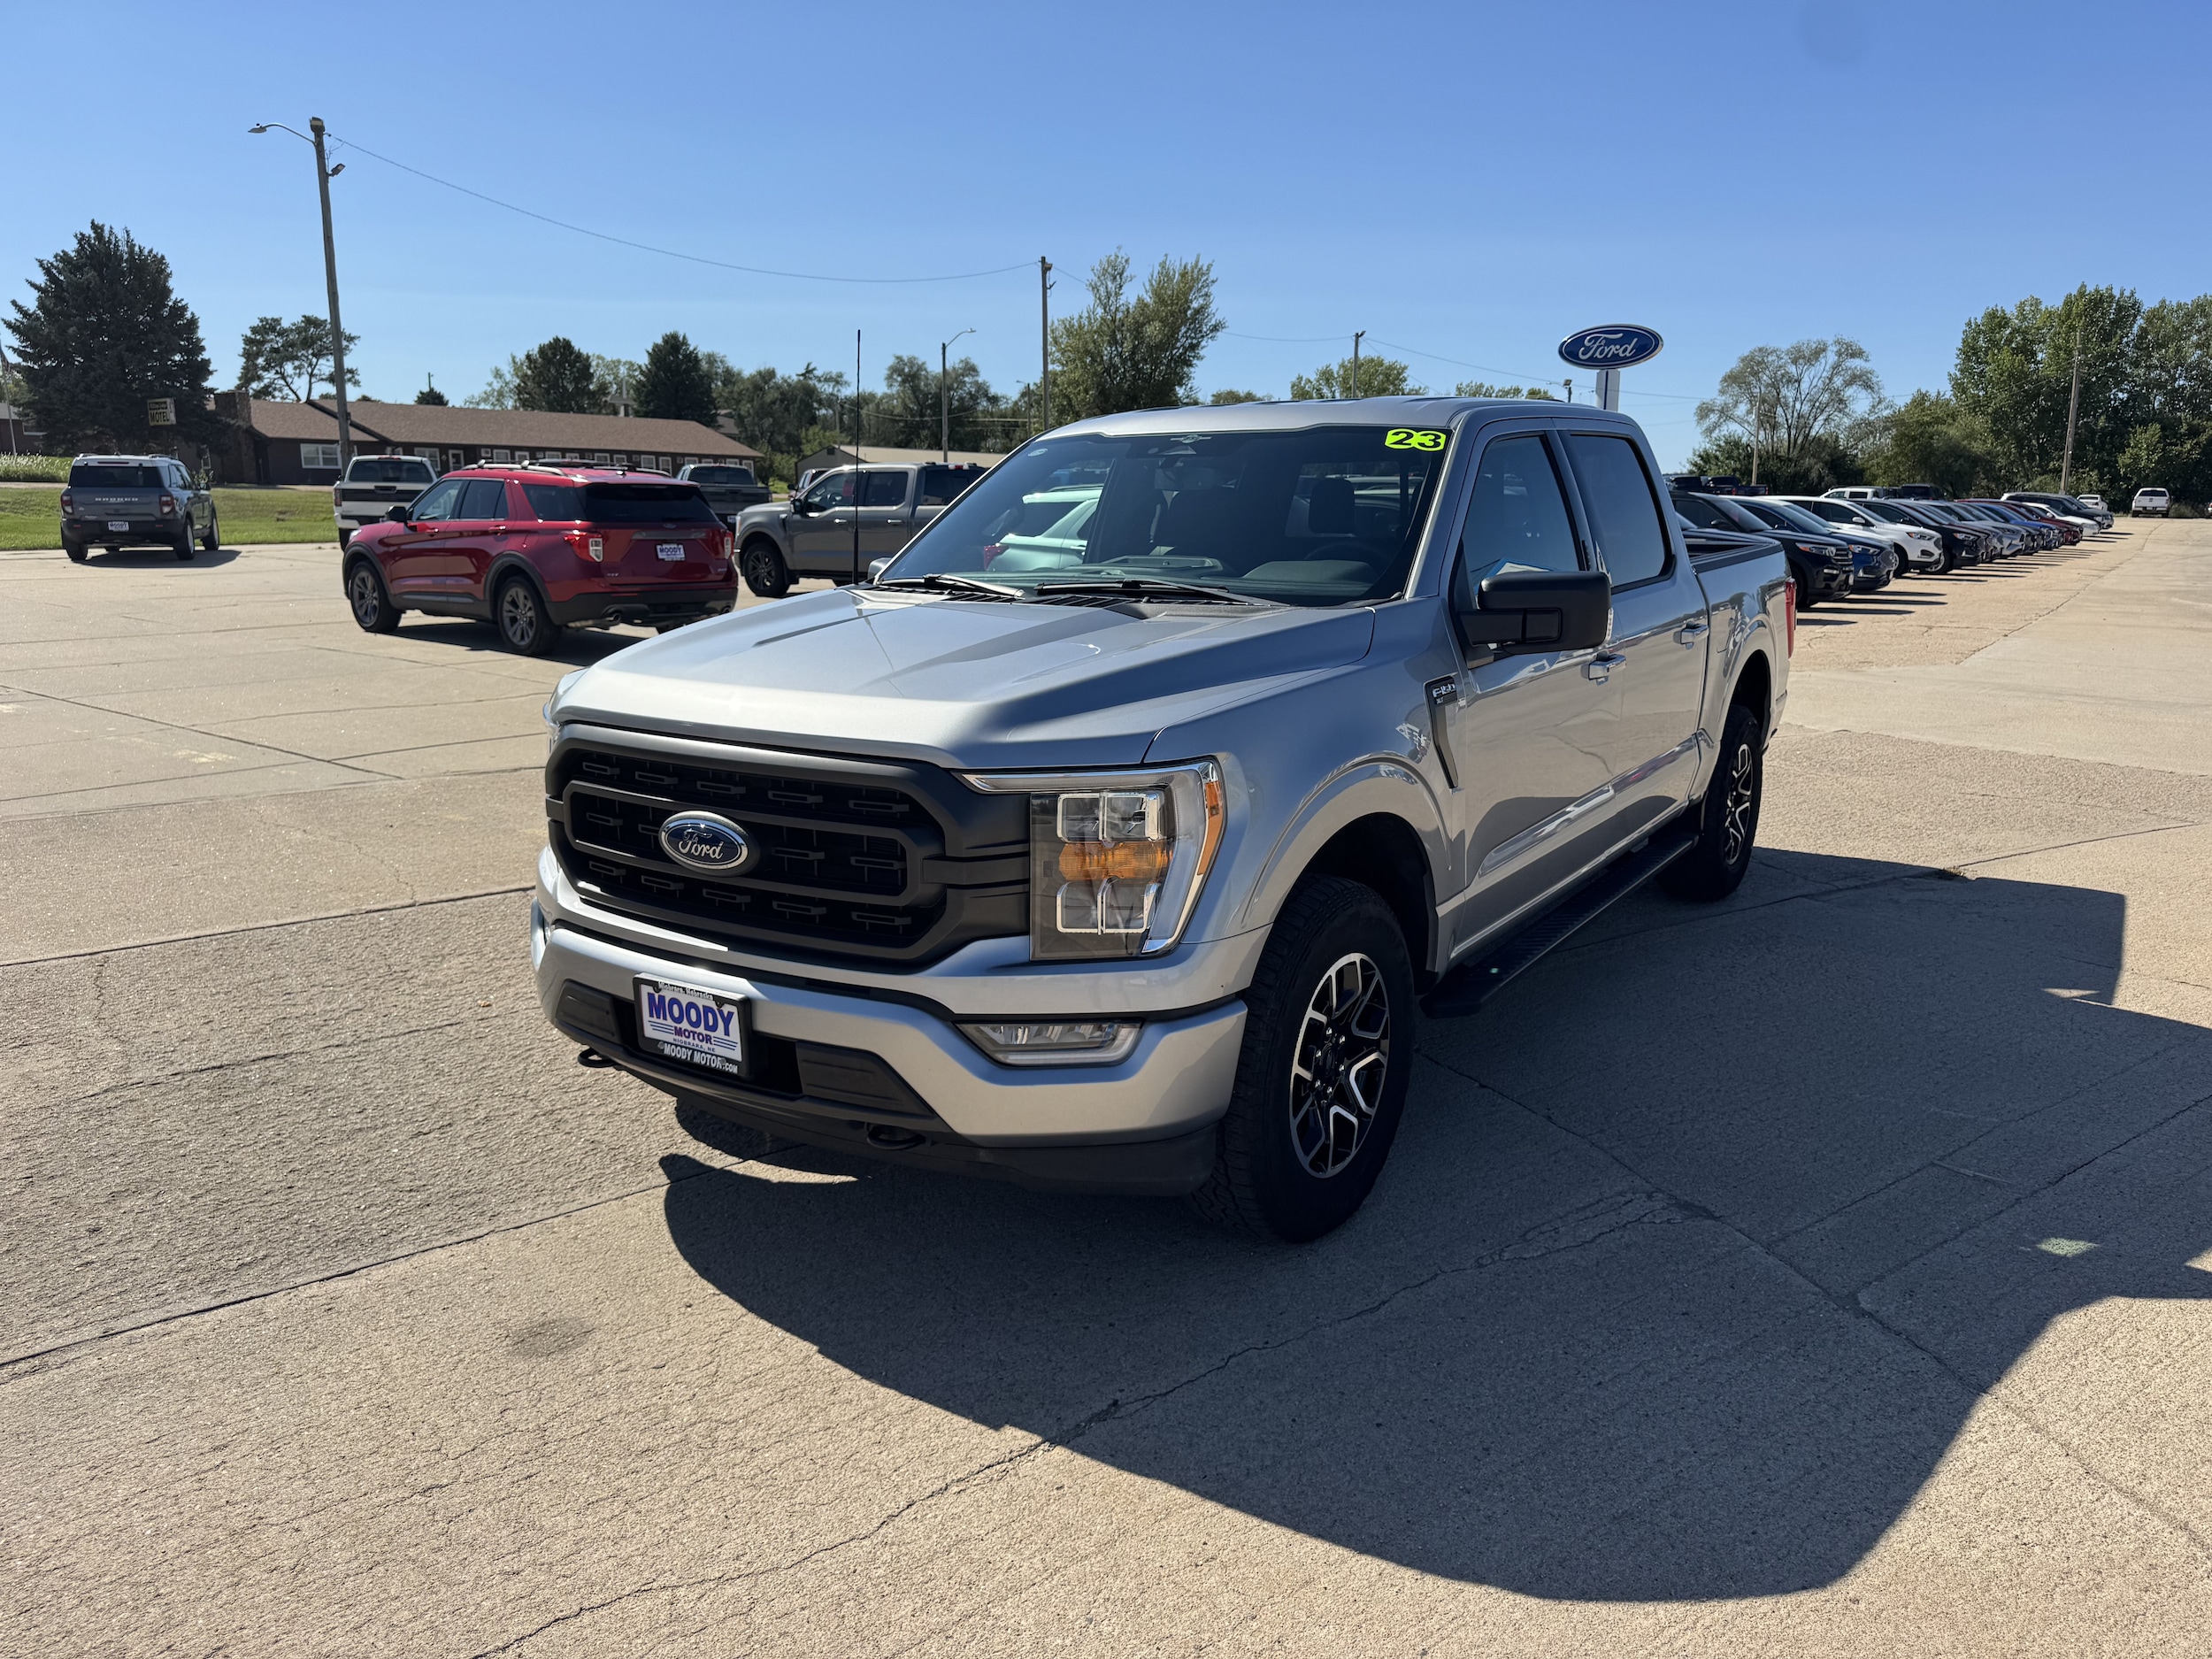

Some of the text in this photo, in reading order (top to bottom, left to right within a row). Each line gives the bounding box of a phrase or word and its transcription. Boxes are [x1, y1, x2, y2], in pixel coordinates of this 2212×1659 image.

[1578, 333, 1638, 360] Ford
[150, 411, 170, 424] MOTEL
[1387, 430, 1443, 449] 23
[678, 828, 724, 859] Ford
[647, 992, 734, 1037] MOODY
[672, 1037, 706, 1050] NIOBRARA,
[673, 1025, 713, 1045] MOTOR
[664, 1042, 692, 1061] MOODY
